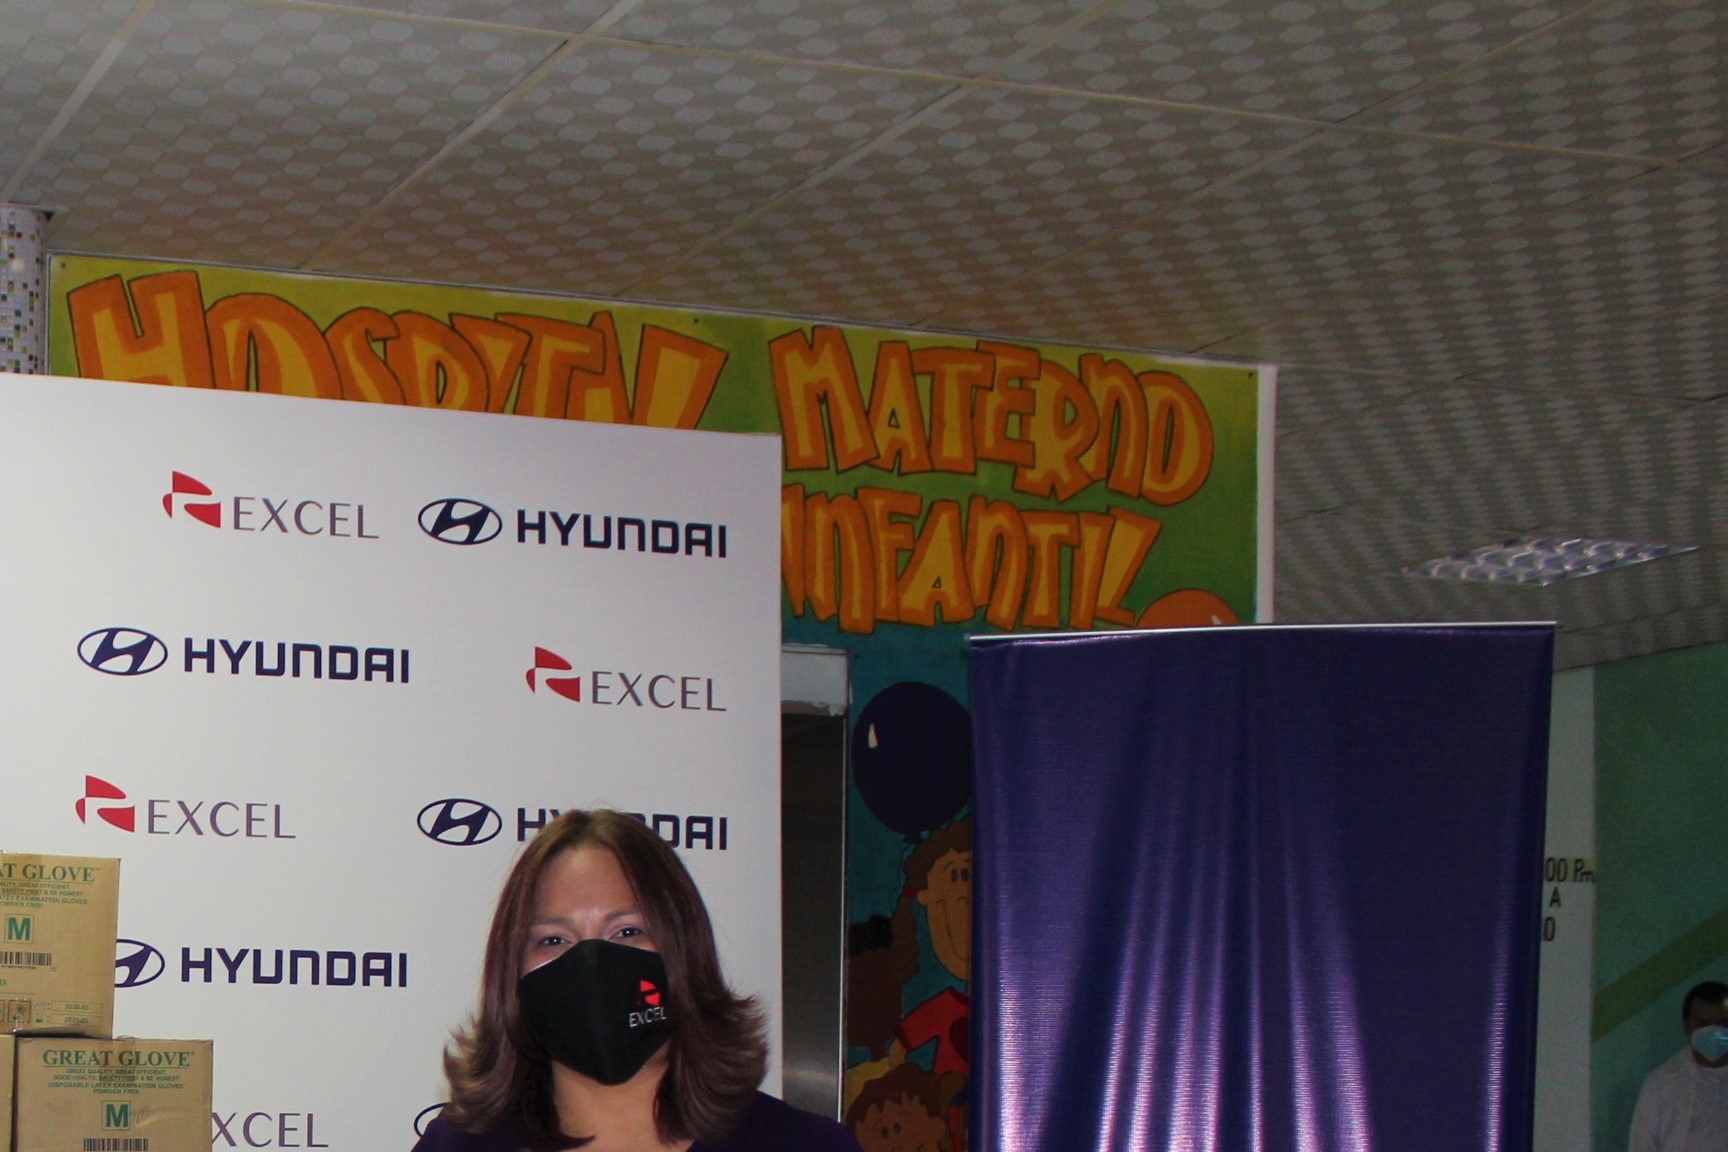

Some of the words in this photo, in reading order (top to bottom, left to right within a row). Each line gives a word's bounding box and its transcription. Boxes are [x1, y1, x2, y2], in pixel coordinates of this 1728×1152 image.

[771, 325, 1213, 506] MATERNO
[233, 496, 379, 541] EXCEL
[518, 510, 727, 559] HYUNDAI
[184, 637, 410, 684] HYUNDAI
[591, 671, 727, 712] EXCEL
[147, 799, 296, 839] EXCEL
[517, 807, 728, 850] HDAI
[22, 864, 95, 882] GLOVE
[8, 917, 30, 940] M
[180, 947, 408, 987] HYUNDAI
[629, 1006, 666, 1027] EXCEL
[43, 1049, 113, 1066] GREAT
[118, 1051, 190, 1066] GLOVE
[106, 1104, 128, 1128] M
[211, 1112, 329, 1149] XCEL
